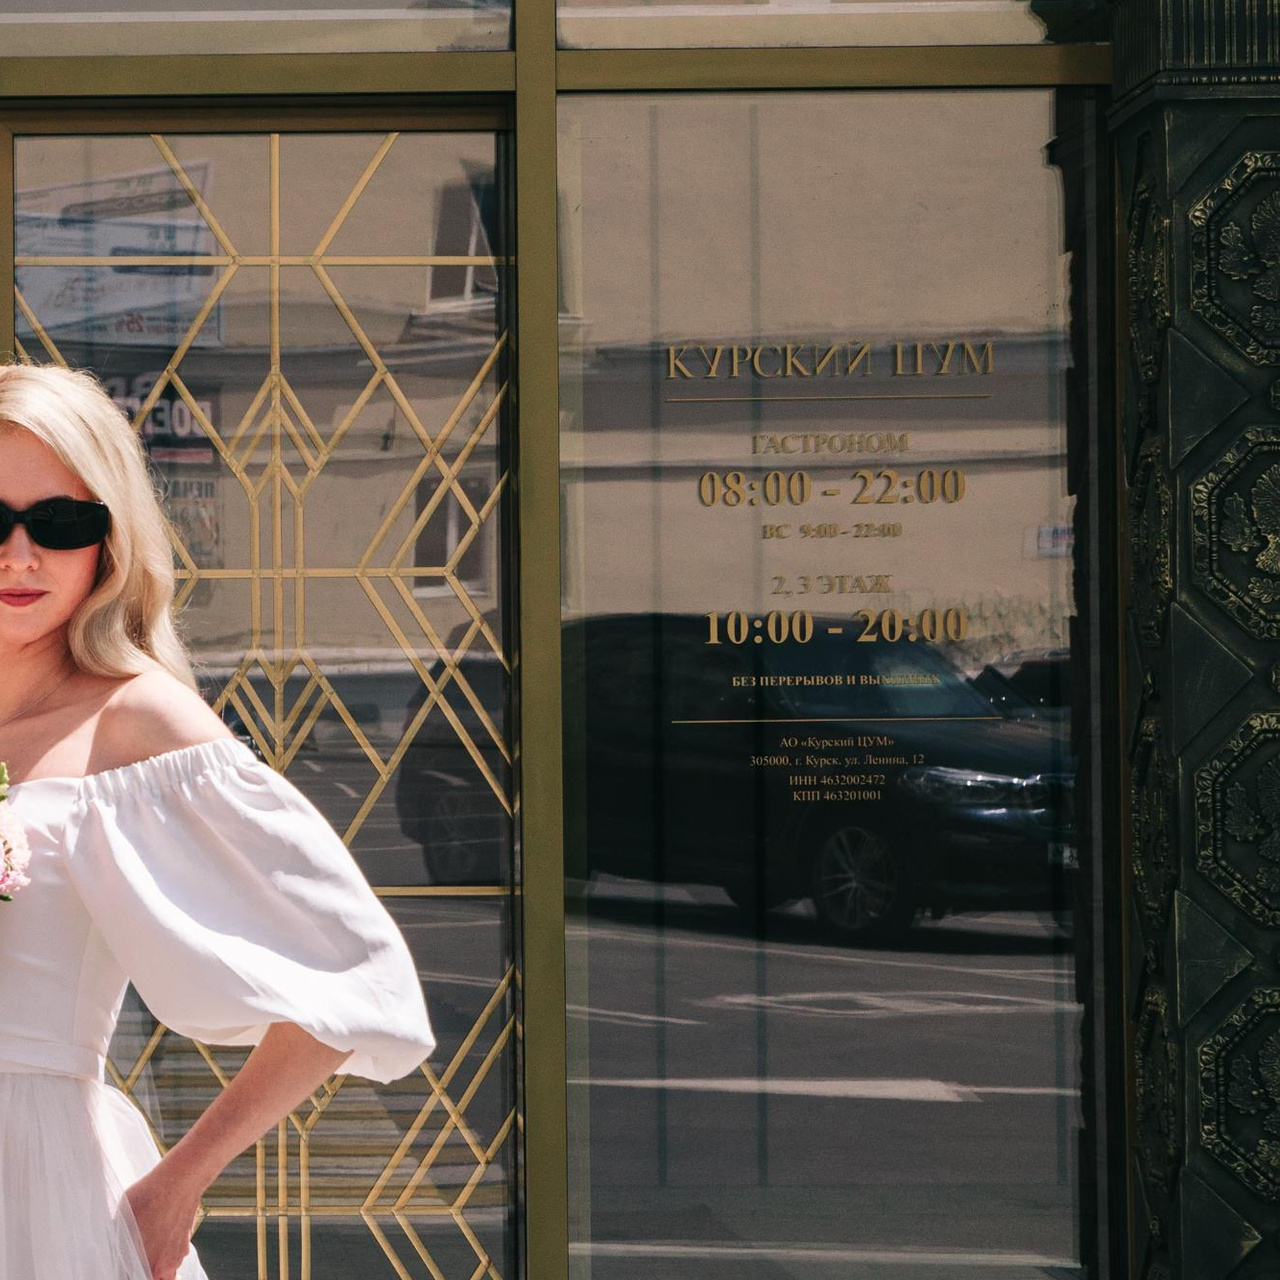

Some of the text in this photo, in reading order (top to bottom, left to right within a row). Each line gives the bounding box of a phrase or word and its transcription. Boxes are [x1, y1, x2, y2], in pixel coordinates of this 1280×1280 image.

[667, 339, 995, 379] КУРСКИЙ ЦУМ
[750, 432, 911, 455] ГАСТРОНОМ
[699, 470, 812, 507] 08:00
[850, 469, 966, 505] 22:00
[761, 523, 792, 540] ВС
[796, 575, 813, 594] 3
[815, 574, 894, 594] ЭТАЖ
[703, 610, 814, 645] 10:00
[854, 608, 969, 643] 20:00
[732, 676, 756, 687] БЕЗ
[759, 675, 843, 687] ПЕРЕРЫВОВ
[846, 675, 856, 685] И
[780, 736, 894, 750] АО «Курский ЦУМ»
[844, 757, 860, 767] ул.
[913, 754, 925, 764] 12
[789, 775, 886, 786] ИНН 4632002472
[793, 790, 881, 801] КПП 463201001
